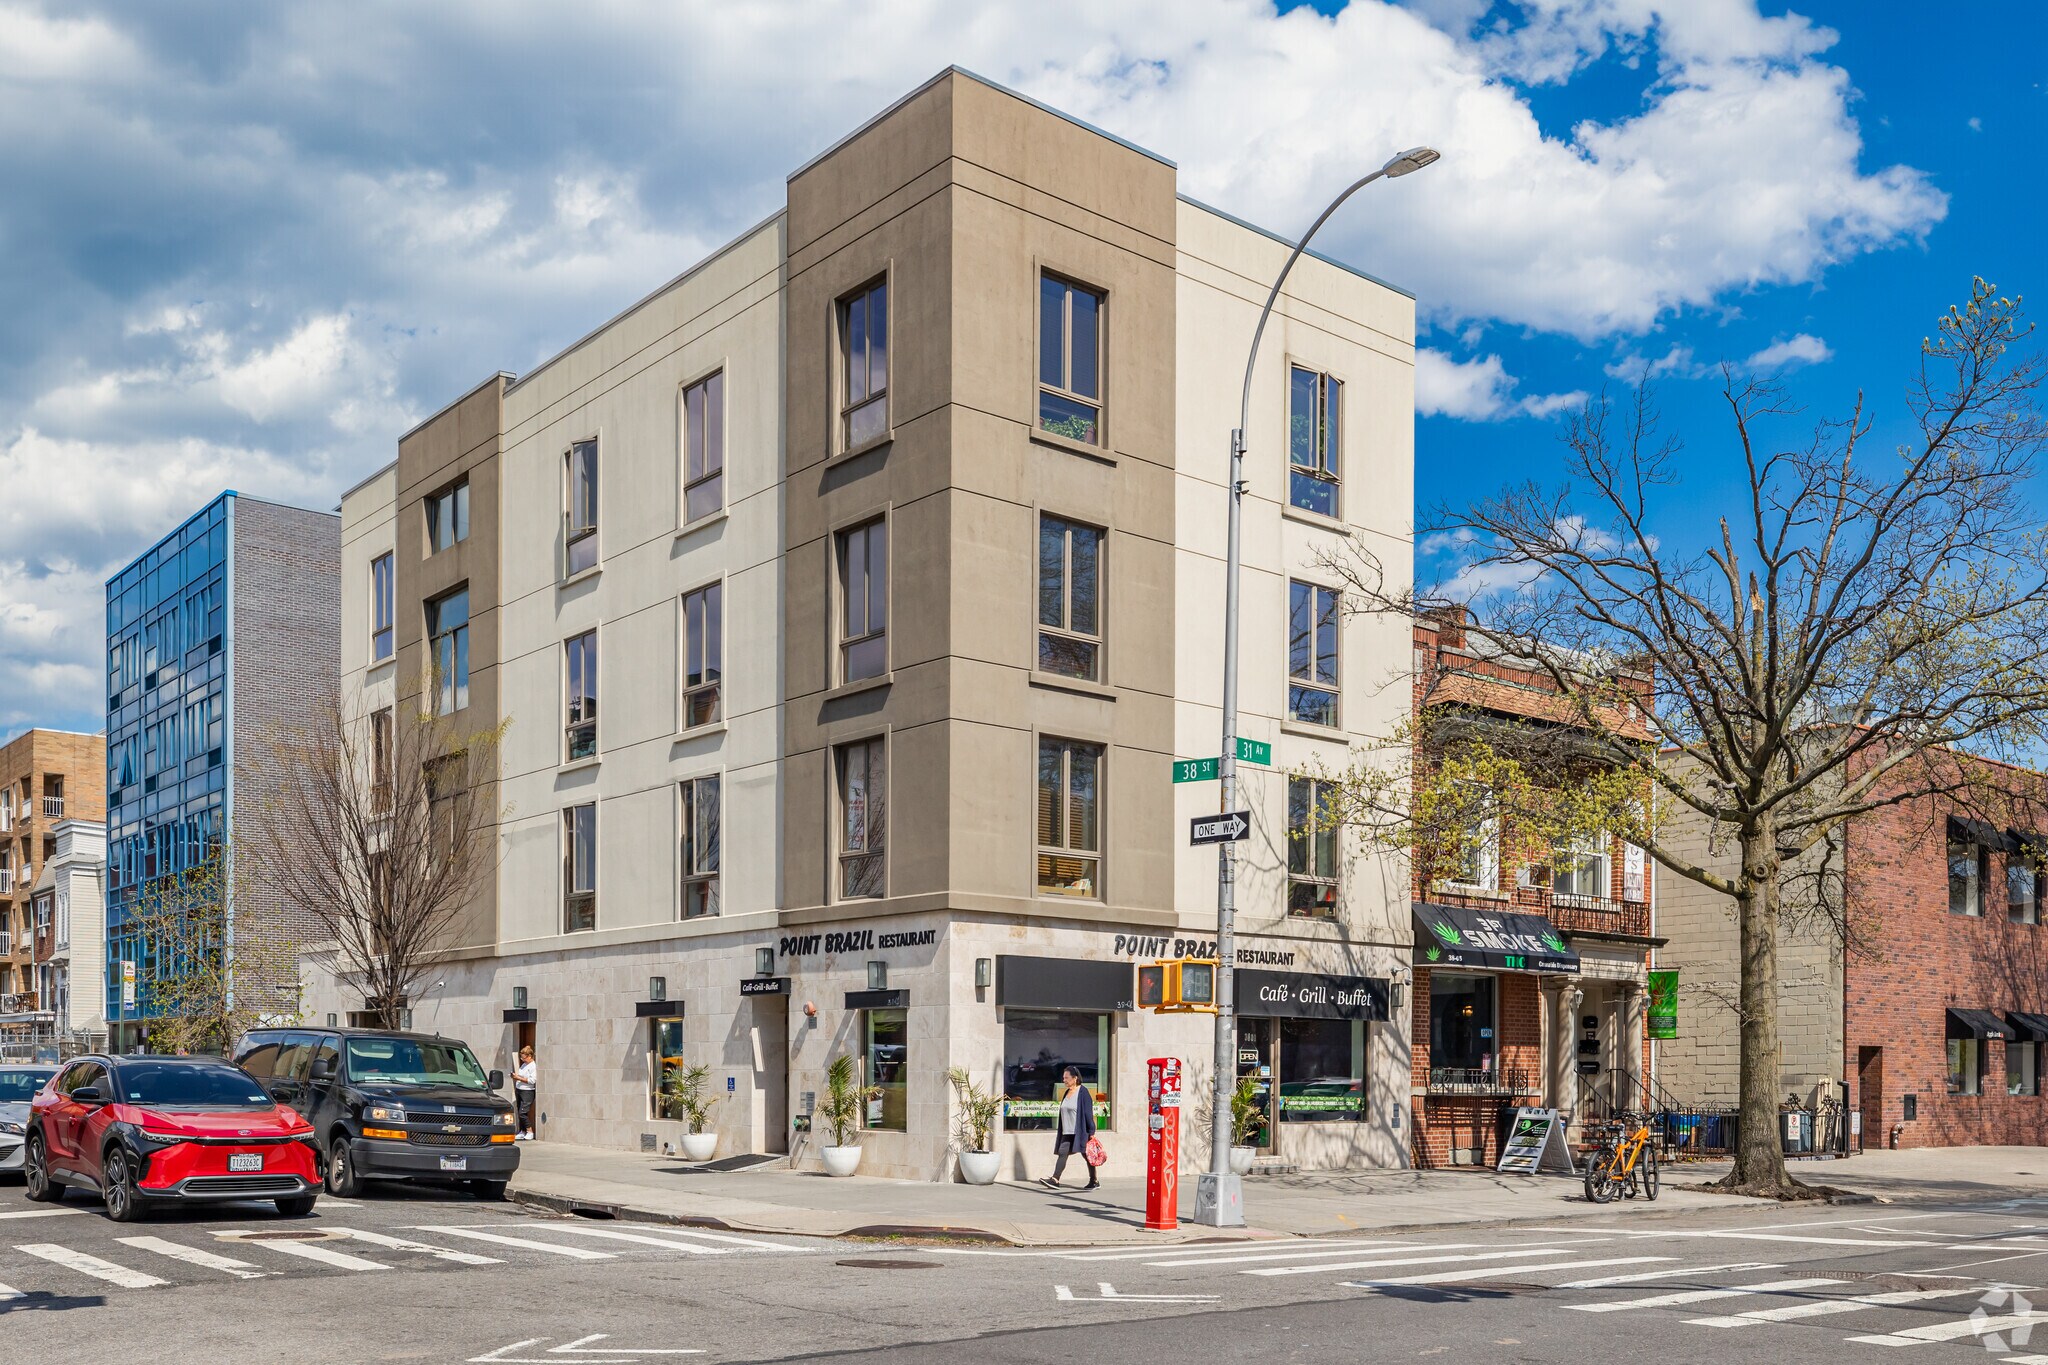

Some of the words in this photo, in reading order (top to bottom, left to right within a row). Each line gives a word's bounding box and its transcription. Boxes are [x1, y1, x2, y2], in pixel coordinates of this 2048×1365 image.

[1243, 742, 1253, 759] 31
[1255, 744, 1264, 756] Av
[1183, 763, 1197, 780] 38
[1202, 761, 1211, 772] St
[1198, 824, 1216, 836] ONE
[1222, 821, 1241, 833] WAY
[780, 934, 822, 957] POINT
[824, 929, 875, 954] BRAZIL
[878, 929, 936, 949] RESTAURANT
[1114, 934, 1170, 958] POINT
[1173, 938, 1218, 958] BRAZ
[1236, 948, 1295, 966] RESTAURANT
[1462, 929, 1547, 953] SMOKE
[1259, 984, 1289, 1002] Café
[1299, 986, 1327, 1004] Grill
[1337, 989, 1372, 1006] Buffet
